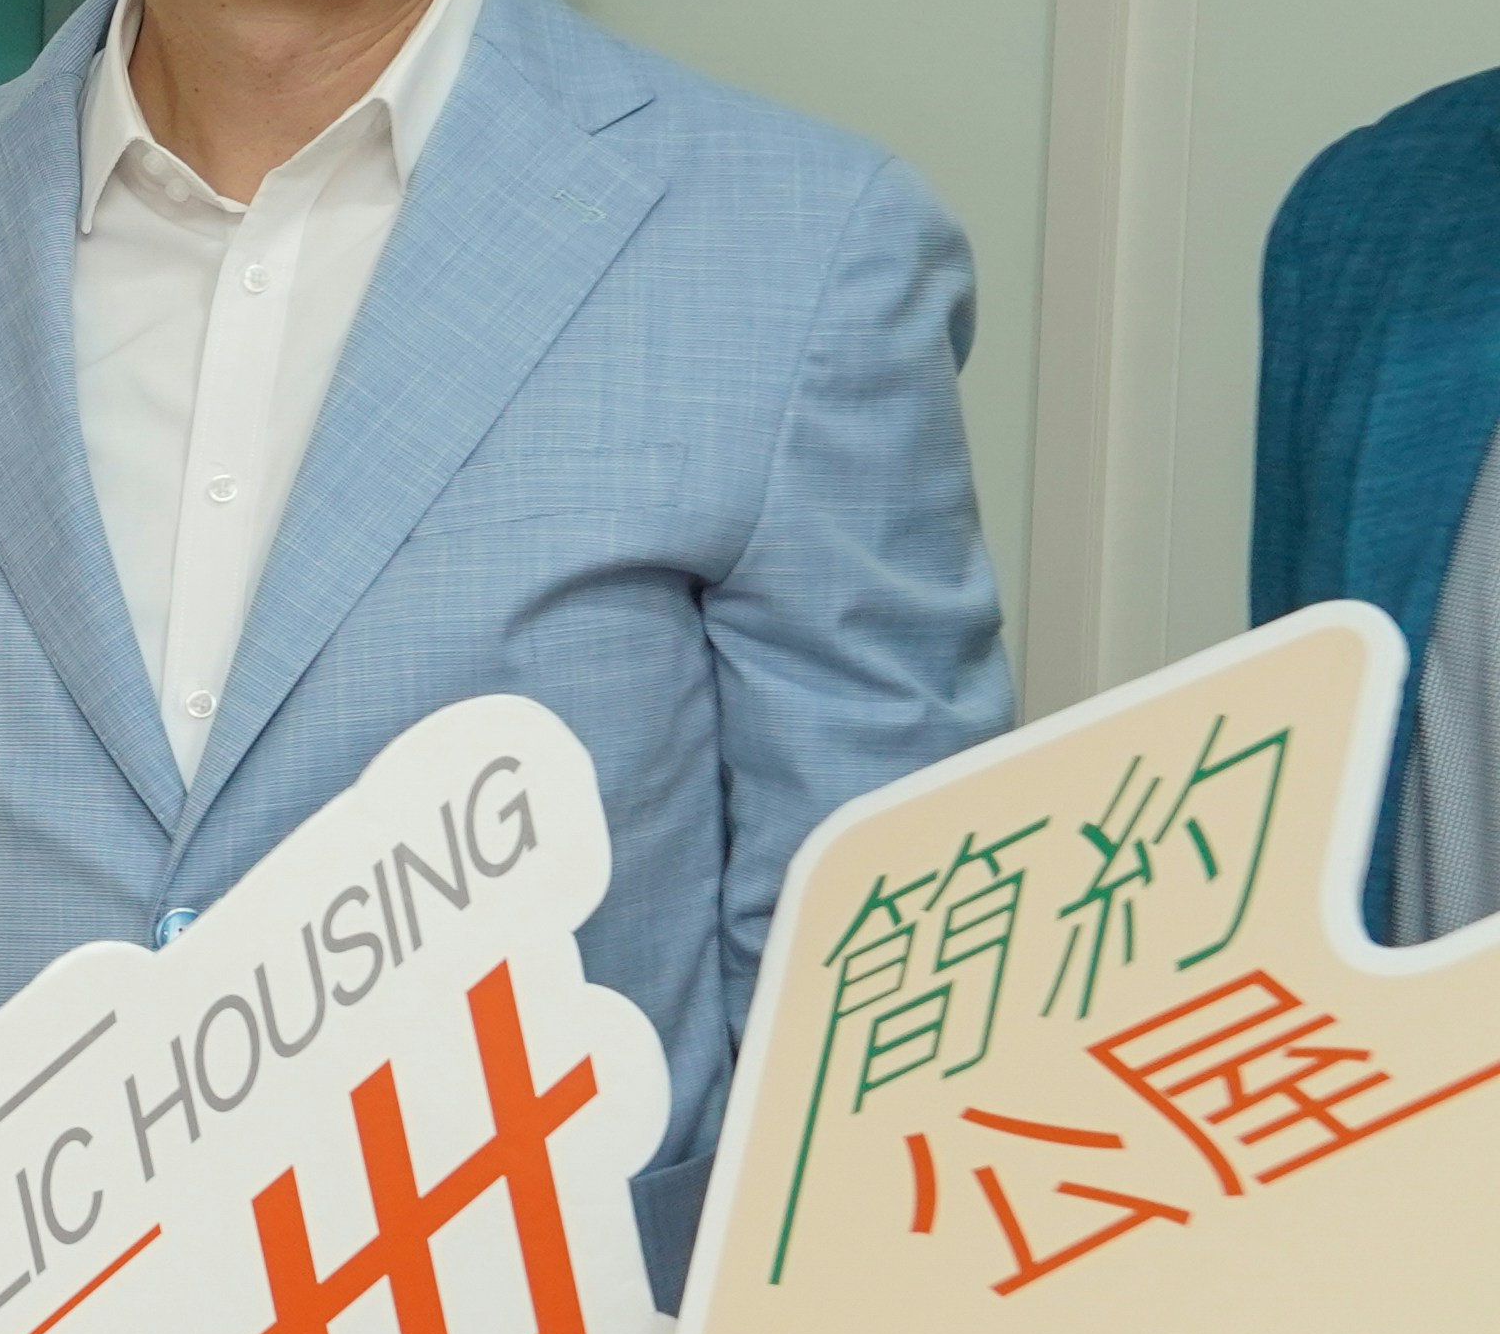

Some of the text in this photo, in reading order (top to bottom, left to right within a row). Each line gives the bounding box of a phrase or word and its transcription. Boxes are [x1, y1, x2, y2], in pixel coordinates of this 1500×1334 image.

[140, 753, 537, 1181] HOUSING
[768, 713, 1292, 1286] 簡約
[904, 968, 1500, 1298] 公屋
